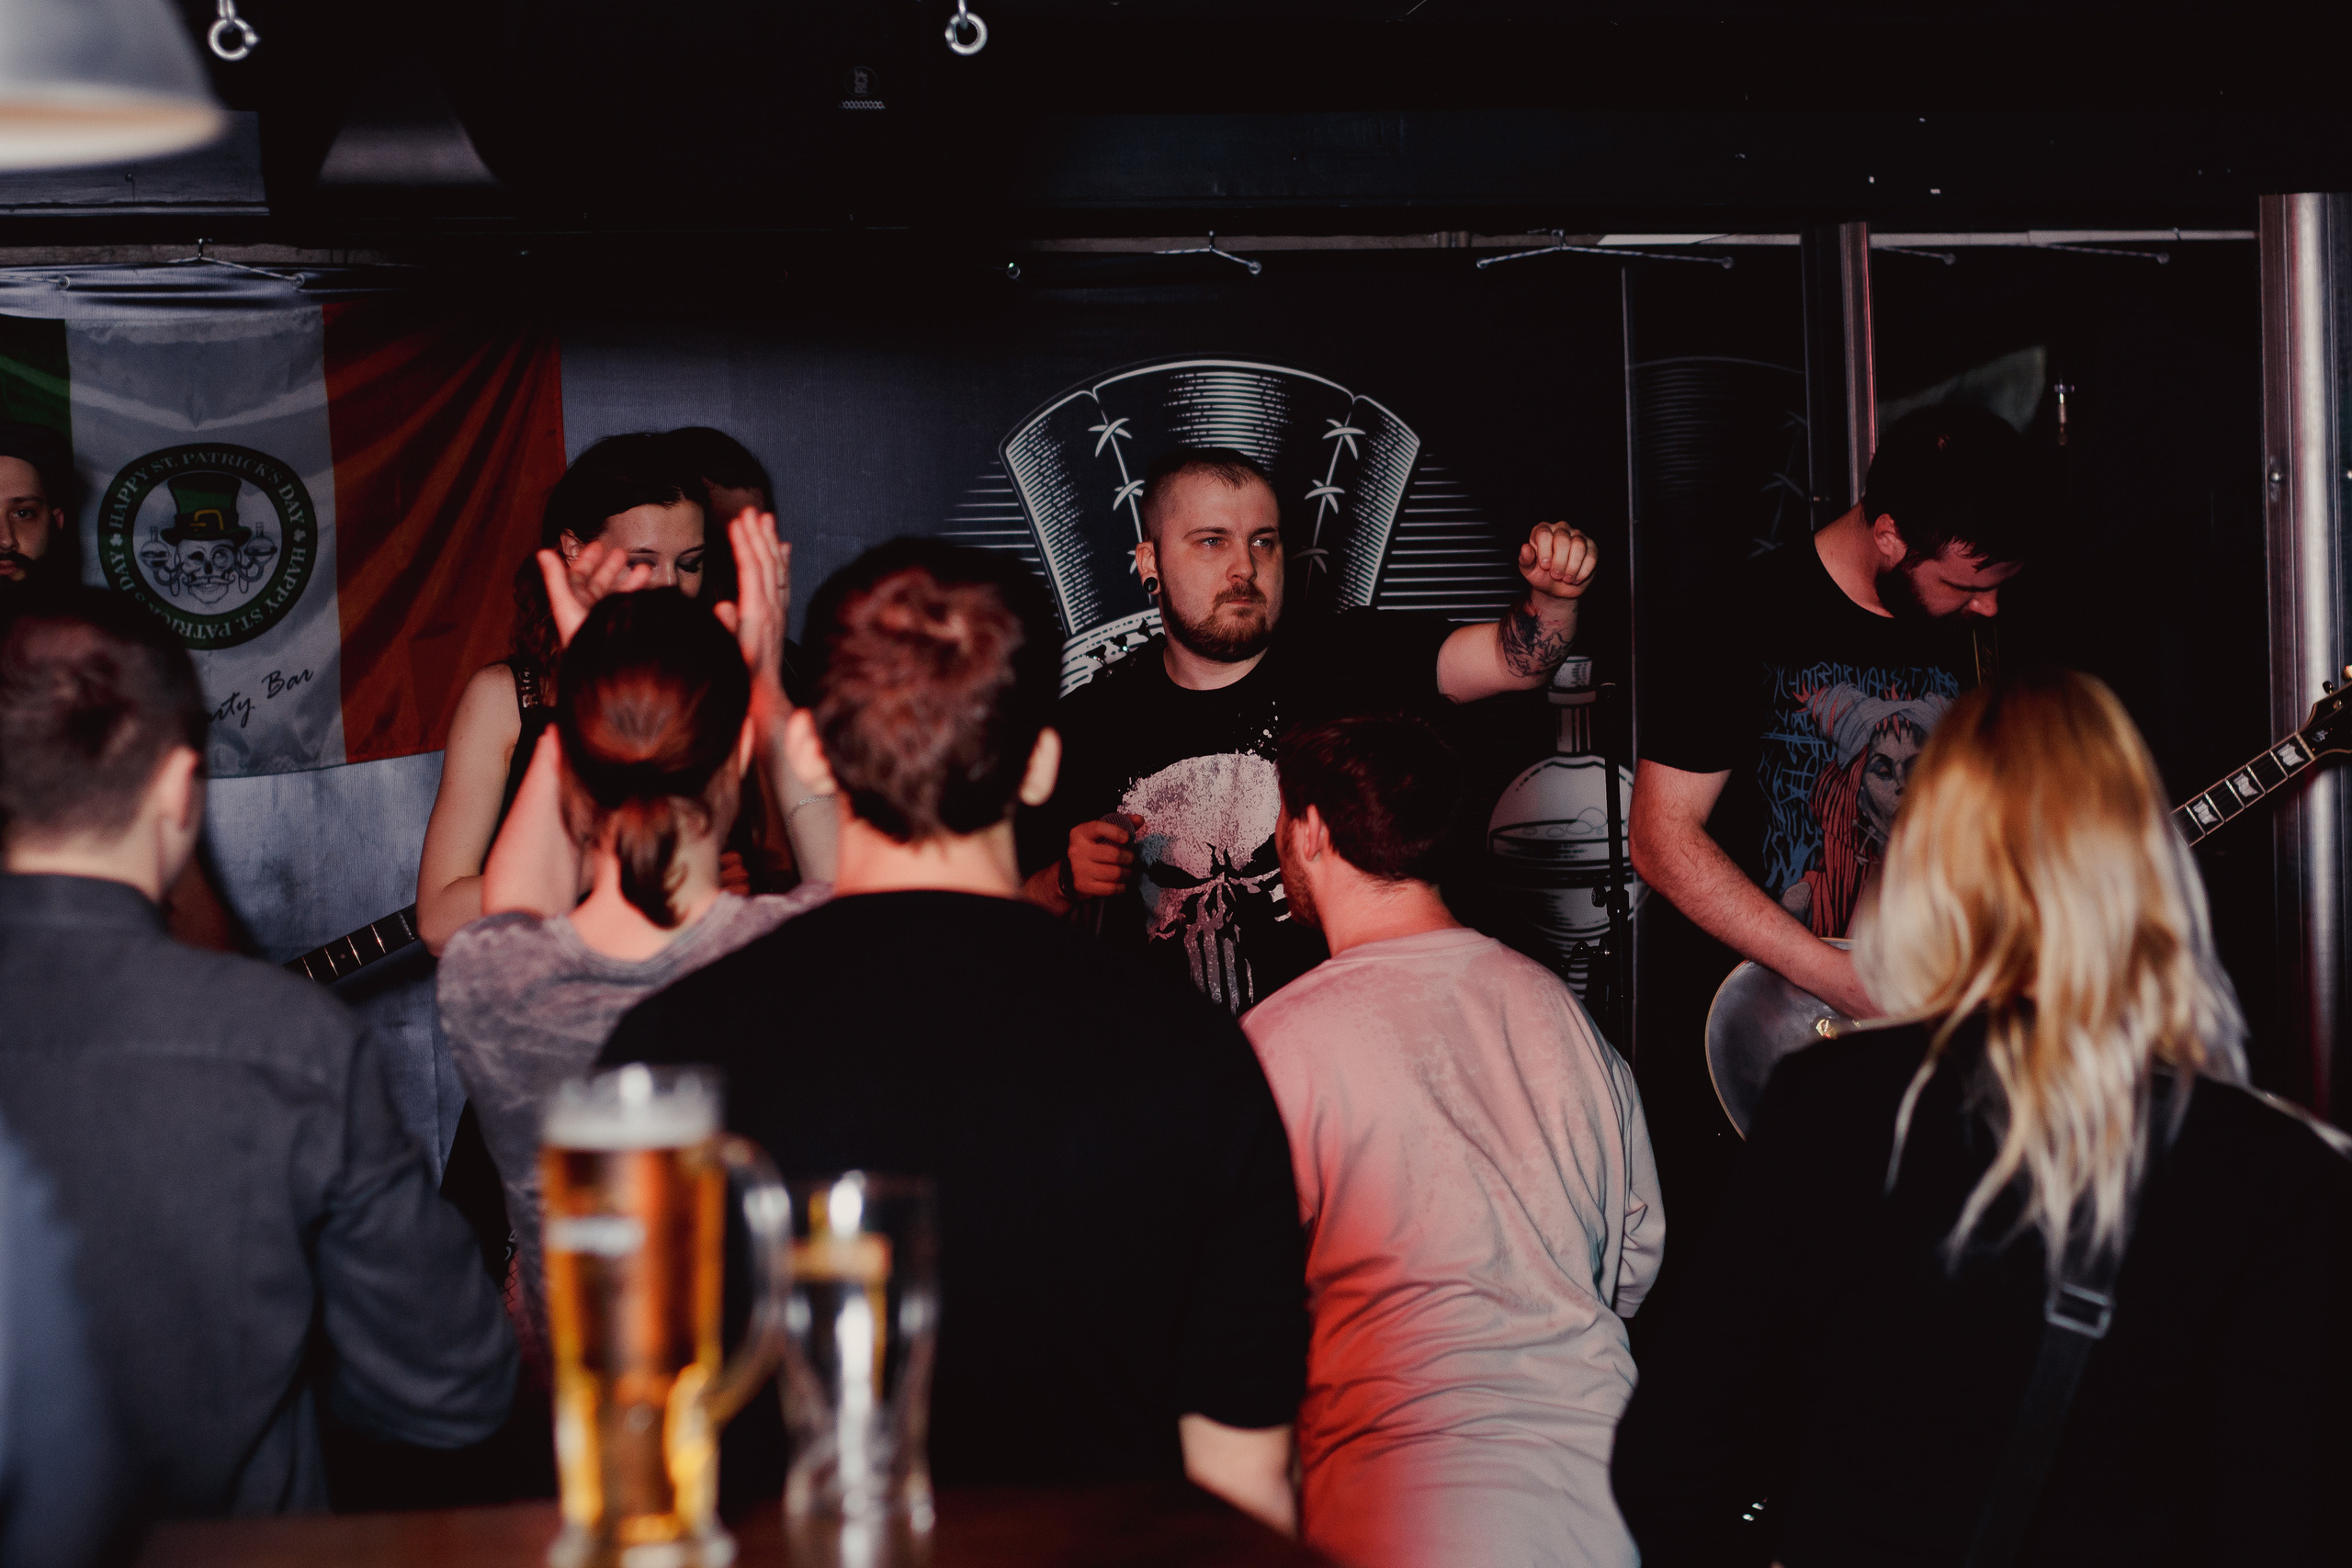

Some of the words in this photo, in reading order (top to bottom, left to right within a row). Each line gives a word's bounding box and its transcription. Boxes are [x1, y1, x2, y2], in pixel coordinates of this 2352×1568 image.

[108, 468, 150, 530] HAPPY
[150, 456, 179, 474] ST.
[183, 451, 283, 485] PATRICK'S
[277, 483, 305, 525] DAY
[109, 550, 137, 592] DAY
[265, 546, 307, 615] HAPPY
[234, 607, 264, 632] ST.
[208, 692, 255, 728] rty
[261, 668, 313, 699] Bar
